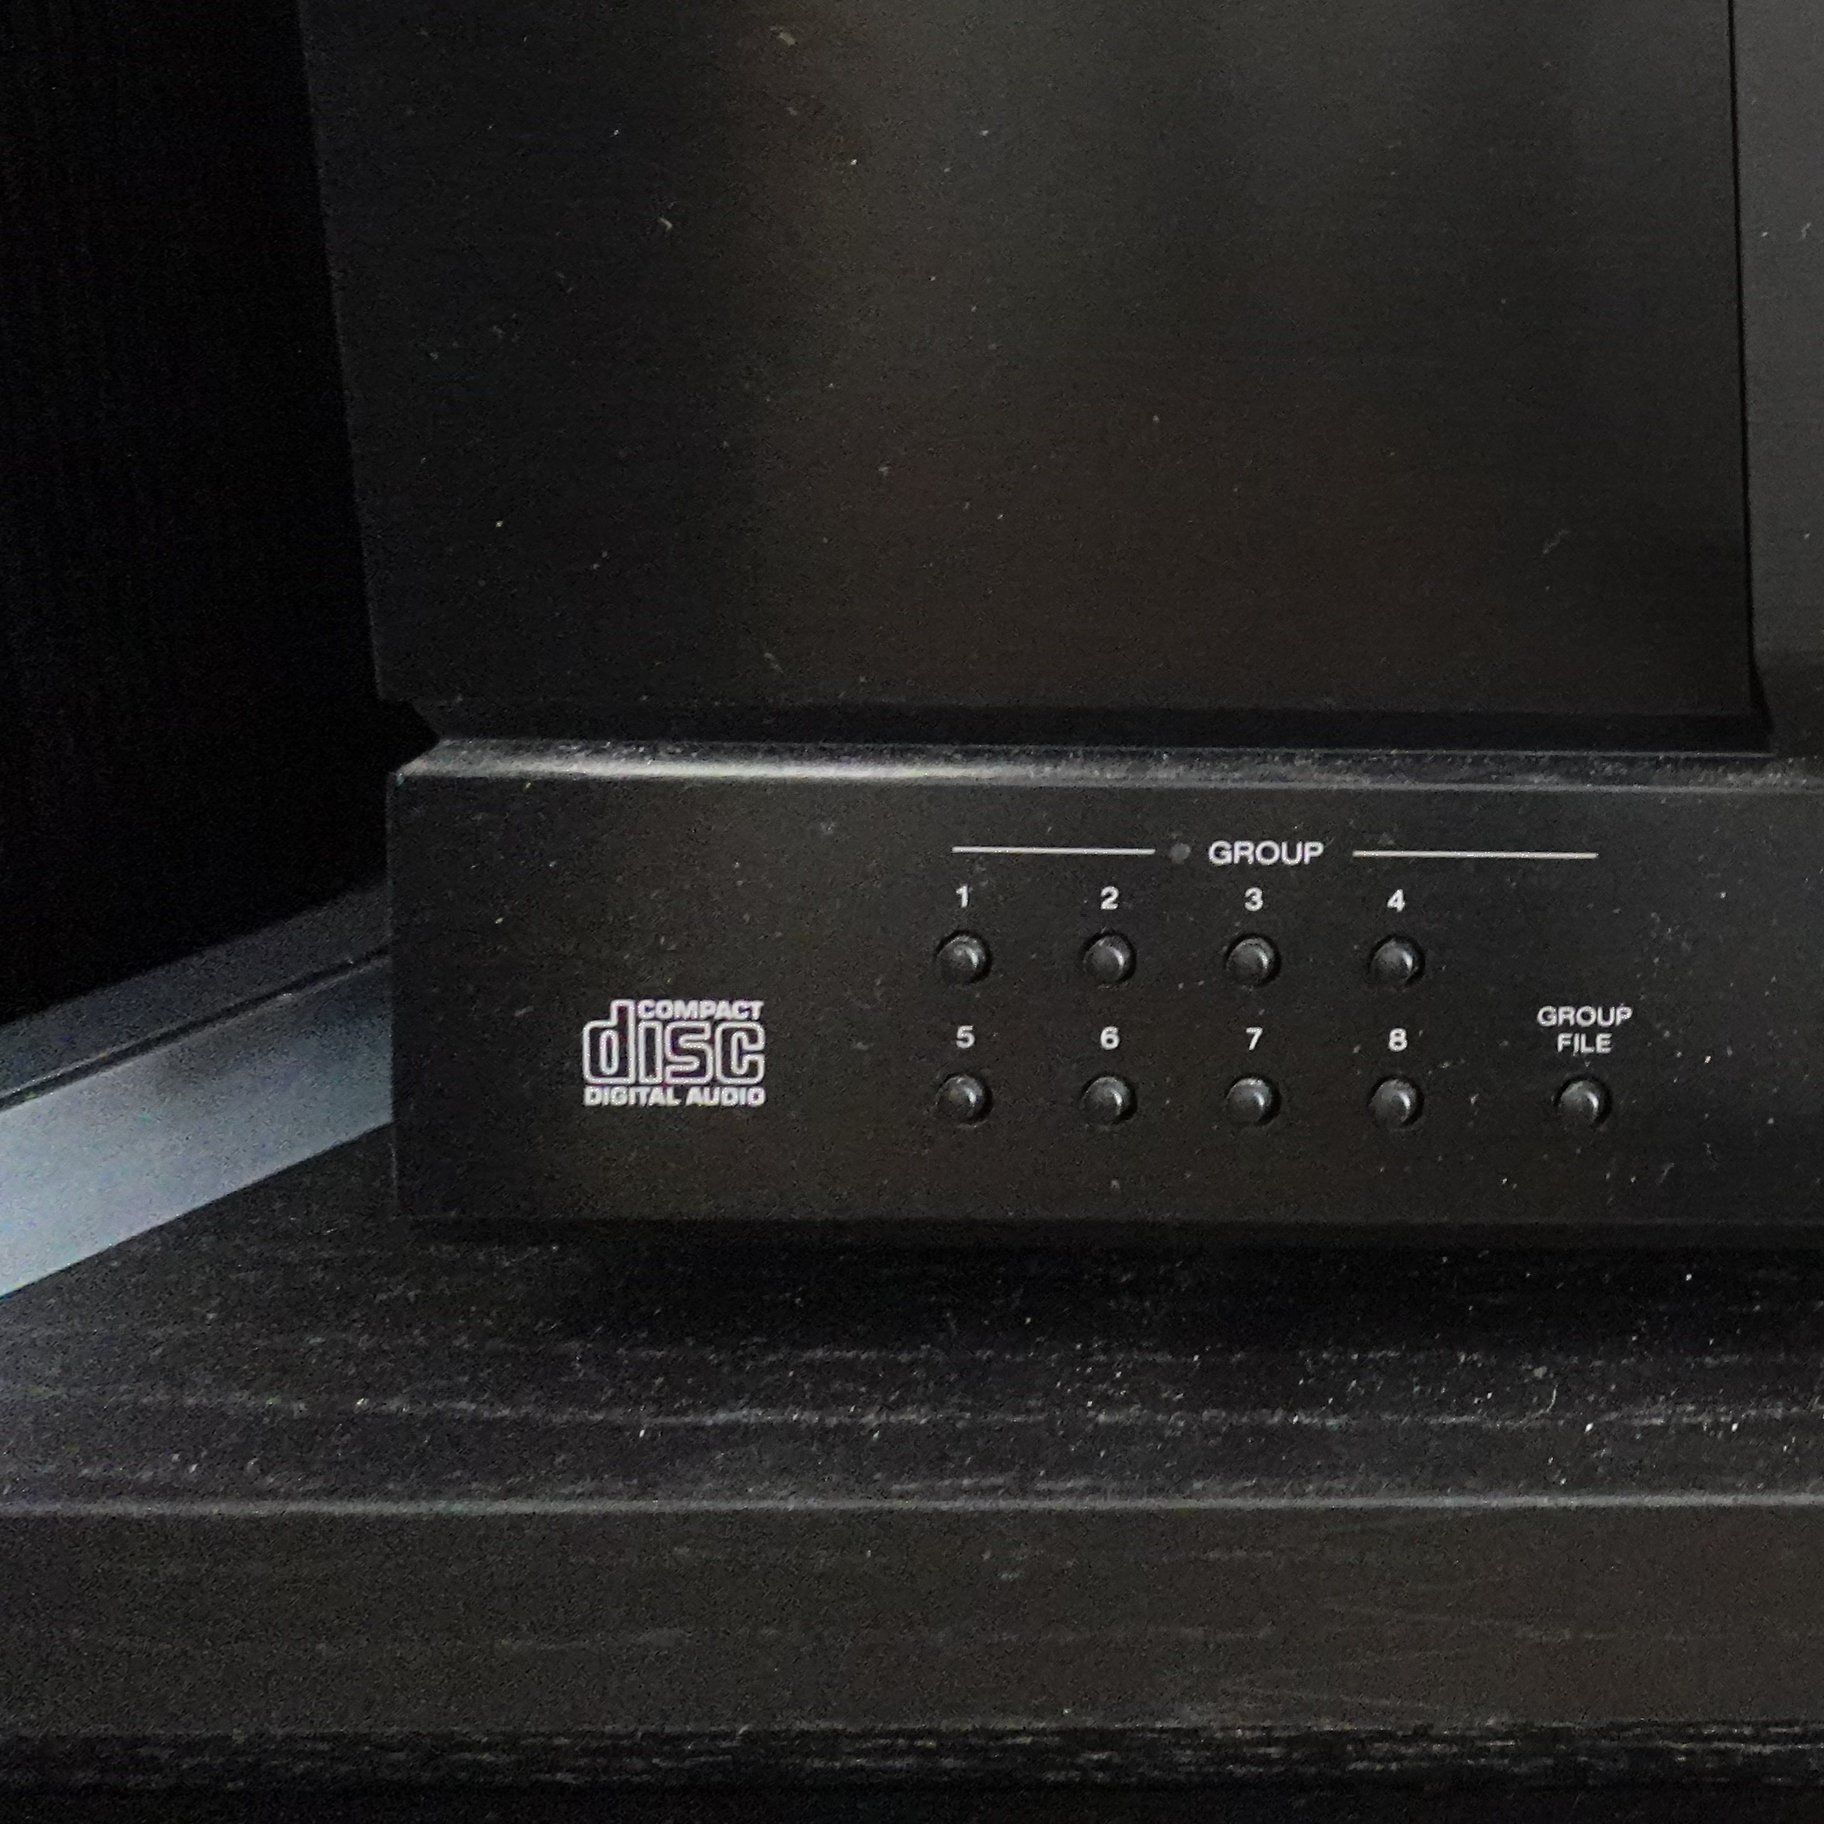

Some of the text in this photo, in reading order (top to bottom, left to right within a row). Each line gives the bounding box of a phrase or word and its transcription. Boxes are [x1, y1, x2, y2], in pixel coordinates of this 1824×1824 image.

[1208, 841, 1324, 865] GROUP
[957, 886, 1406, 910] 1 2 3 4
[637, 1001, 763, 1021] COMPACT
[1538, 1004, 1631, 1027] GROUP
[957, 1027, 1406, 1051] 5 6 7 8
[1556, 1032, 1613, 1054] FILE
[583, 1086, 765, 1106] DIGITAL AUDIO
